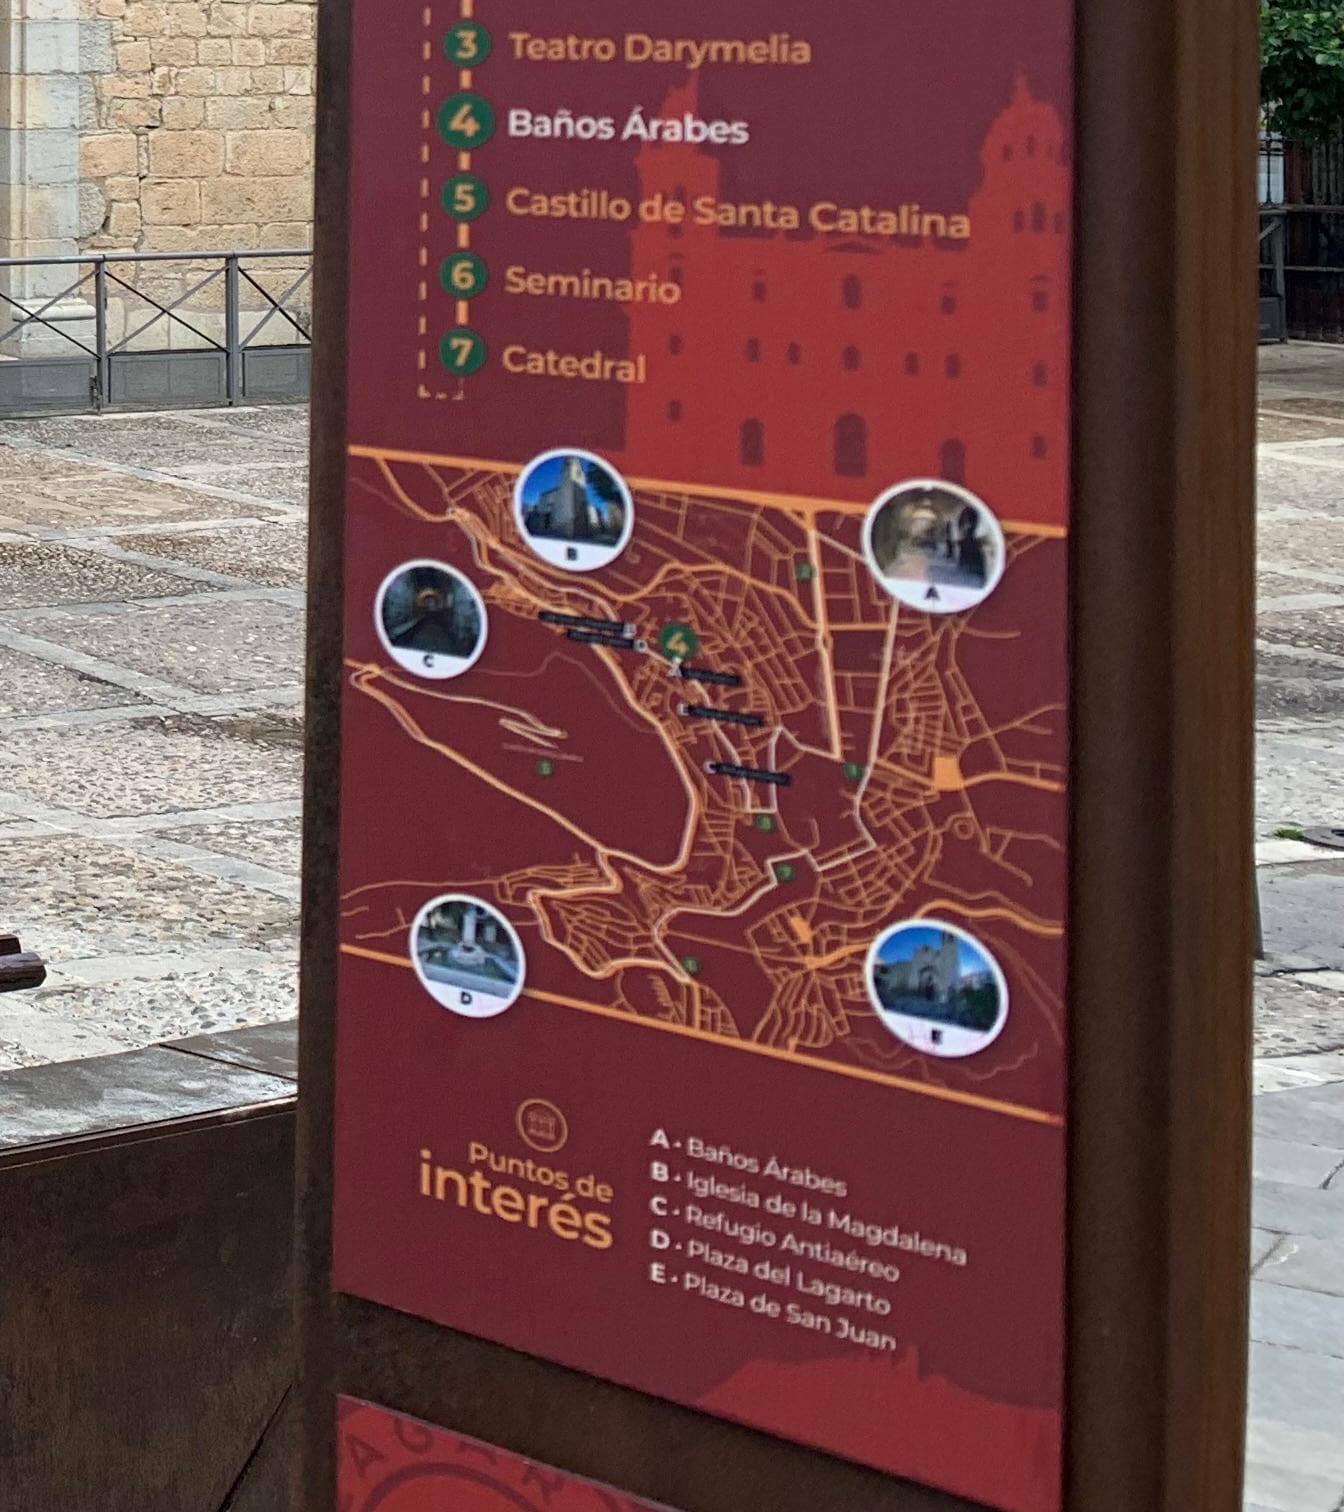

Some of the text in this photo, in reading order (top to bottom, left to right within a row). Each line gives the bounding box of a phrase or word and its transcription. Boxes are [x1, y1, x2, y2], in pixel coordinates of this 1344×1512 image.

[455, 32, 812, 70] 3 Teatro Darymelia
[449, 103, 750, 144] 4 Baños Árabes
[454, 185, 972, 239] 5 Castillo de Santa Catalina
[451, 261, 682, 305] 6 Seminario
[450, 338, 647, 383] 7 Catedral
[460, 991, 473, 1007] D
[468, 1139, 614, 1204] Puntos de
[650, 1128, 848, 1197] A Baños Árabes
[419, 1149, 613, 1250] interés
[650, 1160, 968, 1266] B Iglesia de la Magdalena
[649, 1195, 900, 1282] C Refugio Antiaéreo
[650, 1228, 891, 1316] D Plaza del Lagarto
[650, 1262, 898, 1351] E Plaza de San Juan
